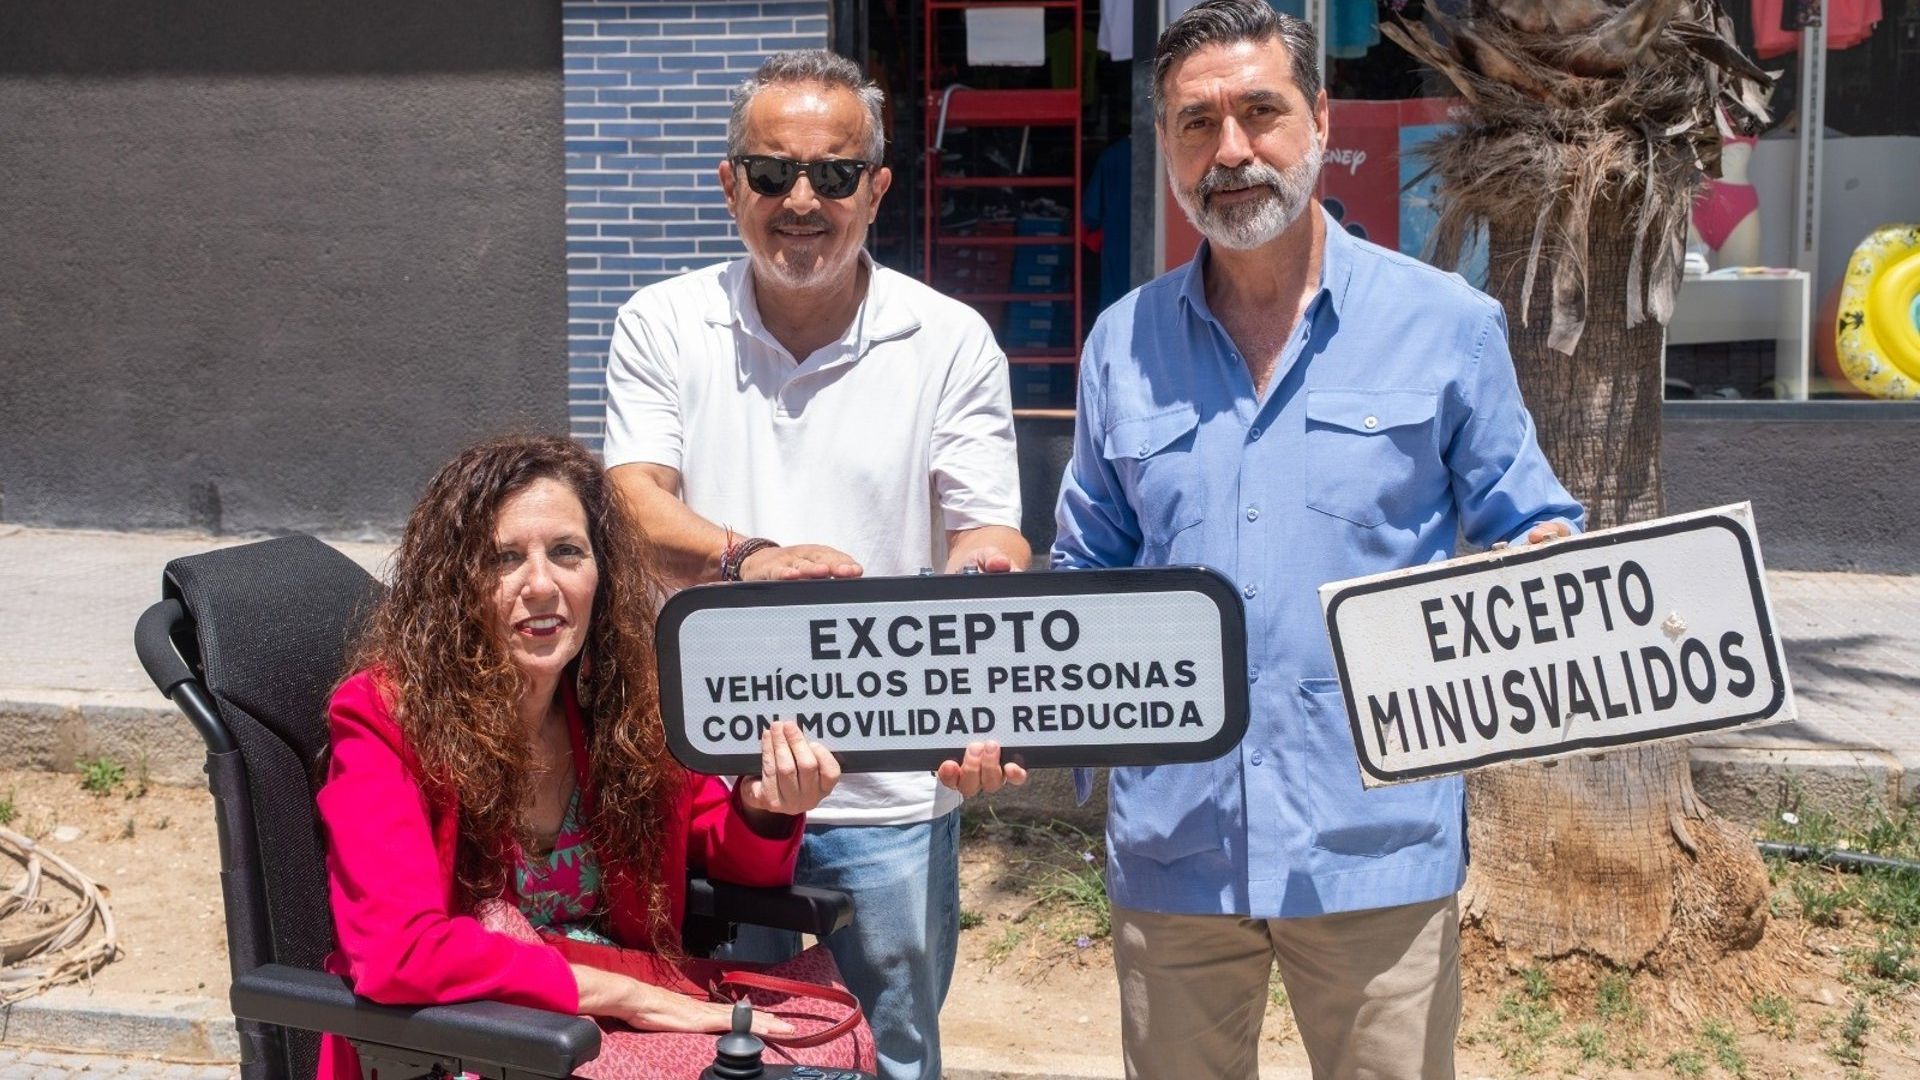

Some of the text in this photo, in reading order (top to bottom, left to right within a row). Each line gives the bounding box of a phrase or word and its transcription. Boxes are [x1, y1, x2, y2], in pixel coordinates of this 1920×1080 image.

[810, 609, 1080, 661] EXCEPTO
[1421, 560, 1655, 663] EXCEPTO
[704, 659, 1197, 703] VEHÍCULOS DE PERSONAS
[1368, 631, 1755, 757] MINUSVALIDOS
[702, 700, 1204, 742] CON MOVILIDAD REDUCIDA
